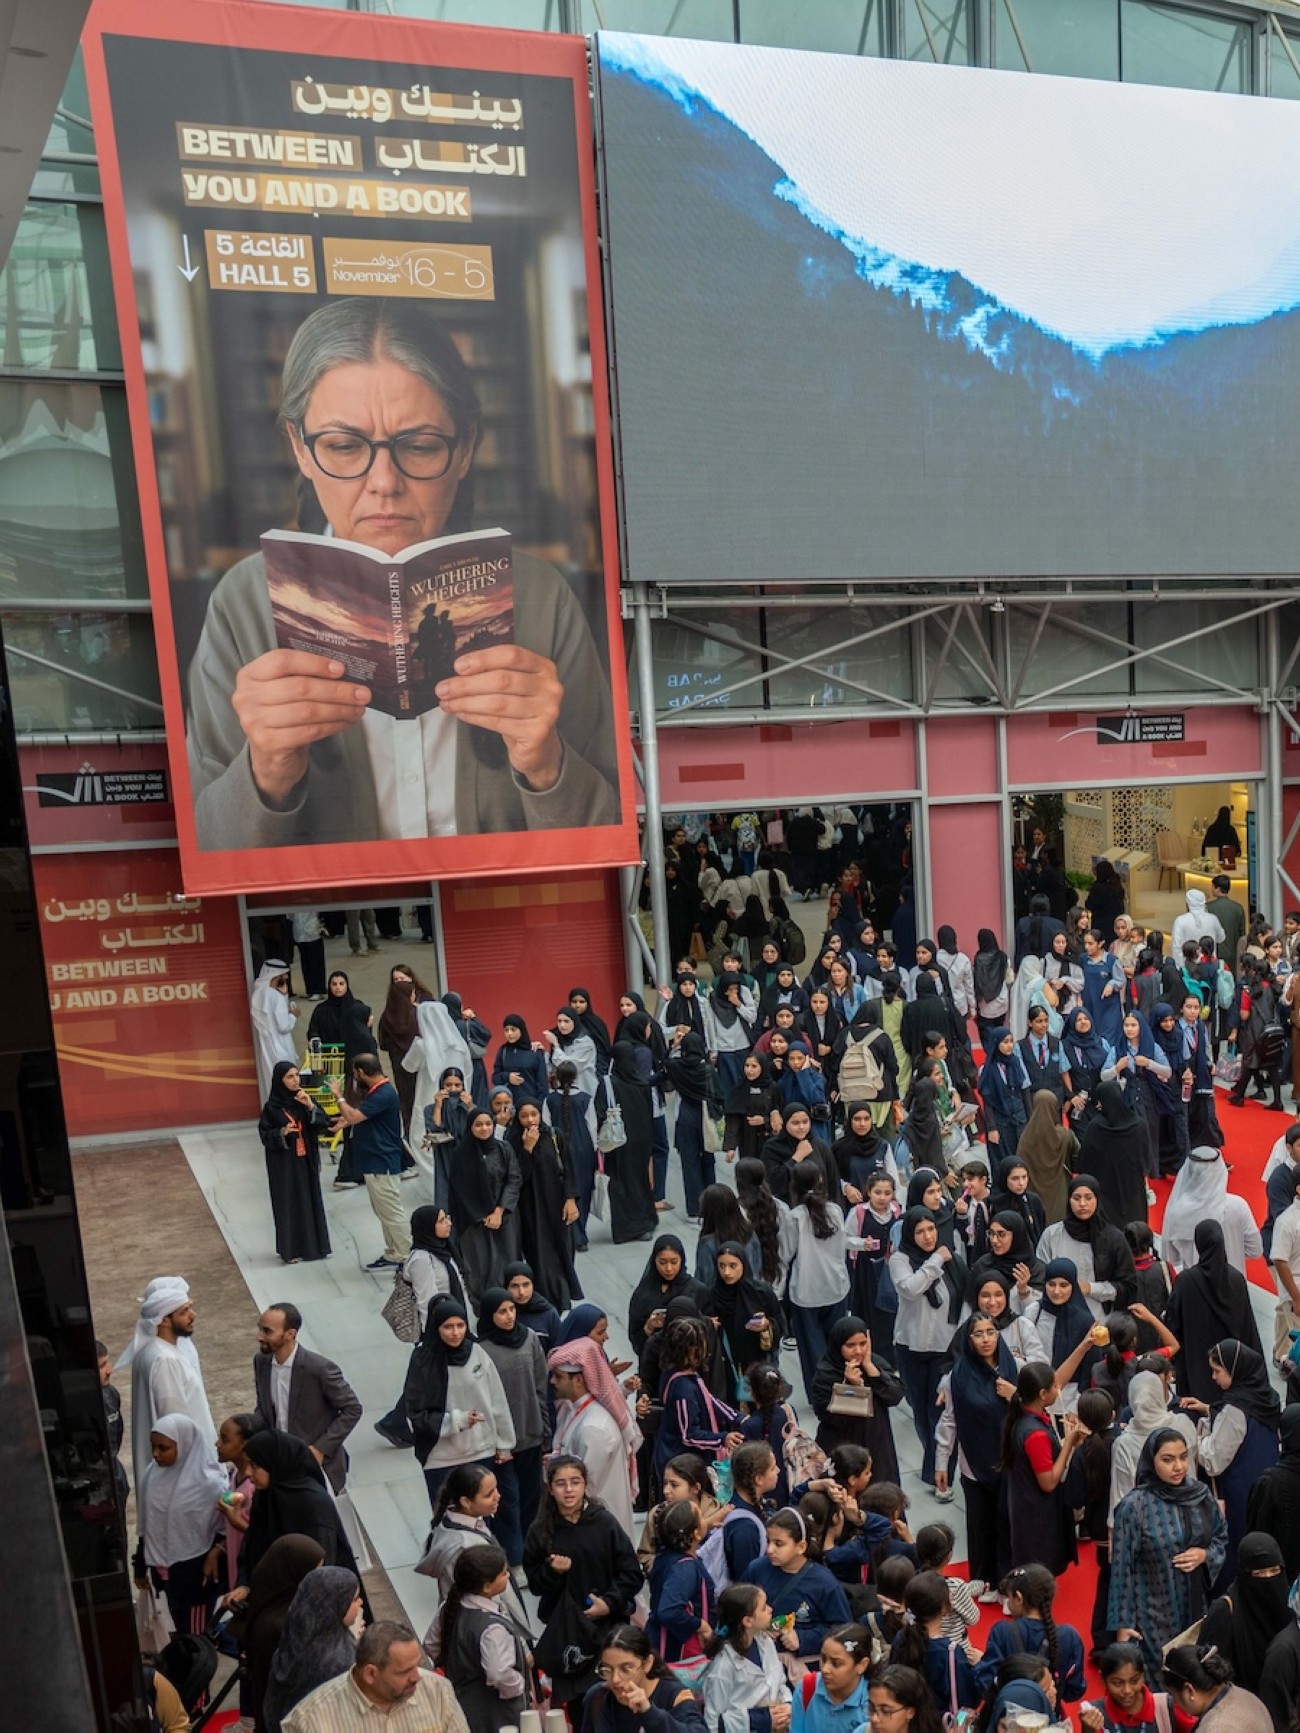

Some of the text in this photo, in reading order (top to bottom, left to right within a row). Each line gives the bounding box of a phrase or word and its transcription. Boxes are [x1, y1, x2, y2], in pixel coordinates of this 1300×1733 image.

[296, 75, 523, 130] بينك وبين
[182, 128, 353, 165] BETWEEN
[379, 139, 526, 176] الكتاب
[184, 173, 469, 216] YOU AND A BOOK
[216, 234, 305, 259] القاعة 5
[220, 263, 311, 287] HALL 5
[333, 269, 400, 283] November
[405, 258, 436, 287] 16
[464, 259, 486, 289] 5
[410, 557, 509, 596] WUTHERING
[426, 573, 497, 604] HEIGHTS
[388, 571, 402, 618] HEIGHTS
[392, 619, 407, 684] WUTHERING
[104, 774, 145, 783] BETWEEN
[125, 783, 142, 791] YOU
[145, 782, 162, 791] AND
[106, 794, 114, 802] A
[114, 793, 139, 801] BOOK
[45, 897, 111, 922] وبين
[102, 923, 205, 954] الكتاب
[53, 957, 167, 982] BETWEEN
[66, 988, 118, 1010] AND
[122, 986, 140, 1005] A
[143, 982, 208, 1004] BOOK
